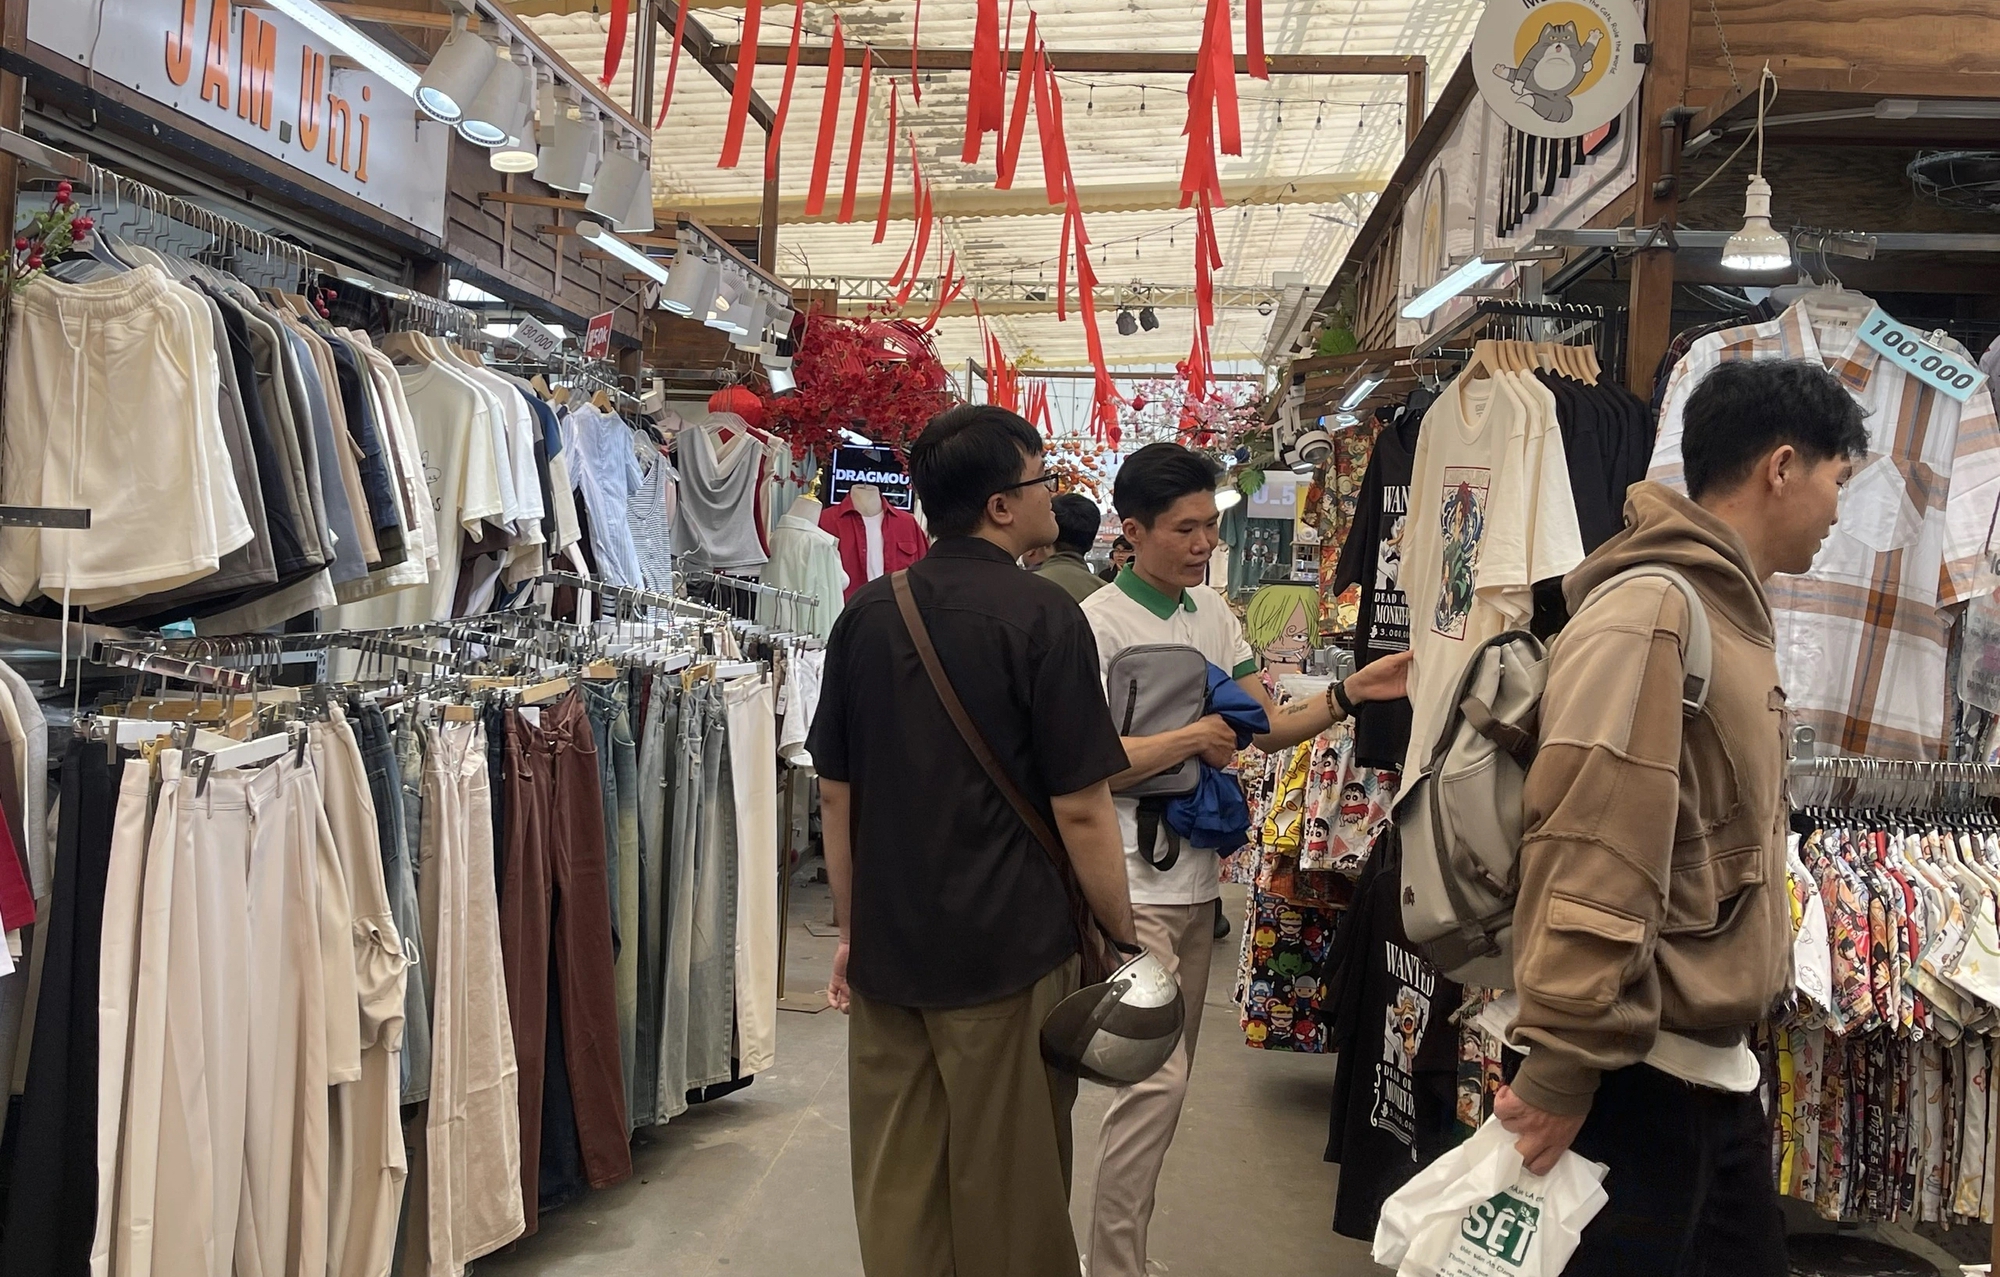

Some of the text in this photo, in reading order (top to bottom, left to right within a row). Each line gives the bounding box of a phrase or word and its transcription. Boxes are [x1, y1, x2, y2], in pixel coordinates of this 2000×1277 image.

[520, 324, 553, 350] 130.000
[1869, 319, 1974, 390] 100.000
[1374, 592, 1397, 604] DEAD
[1385, 940, 1436, 998] WANTED
